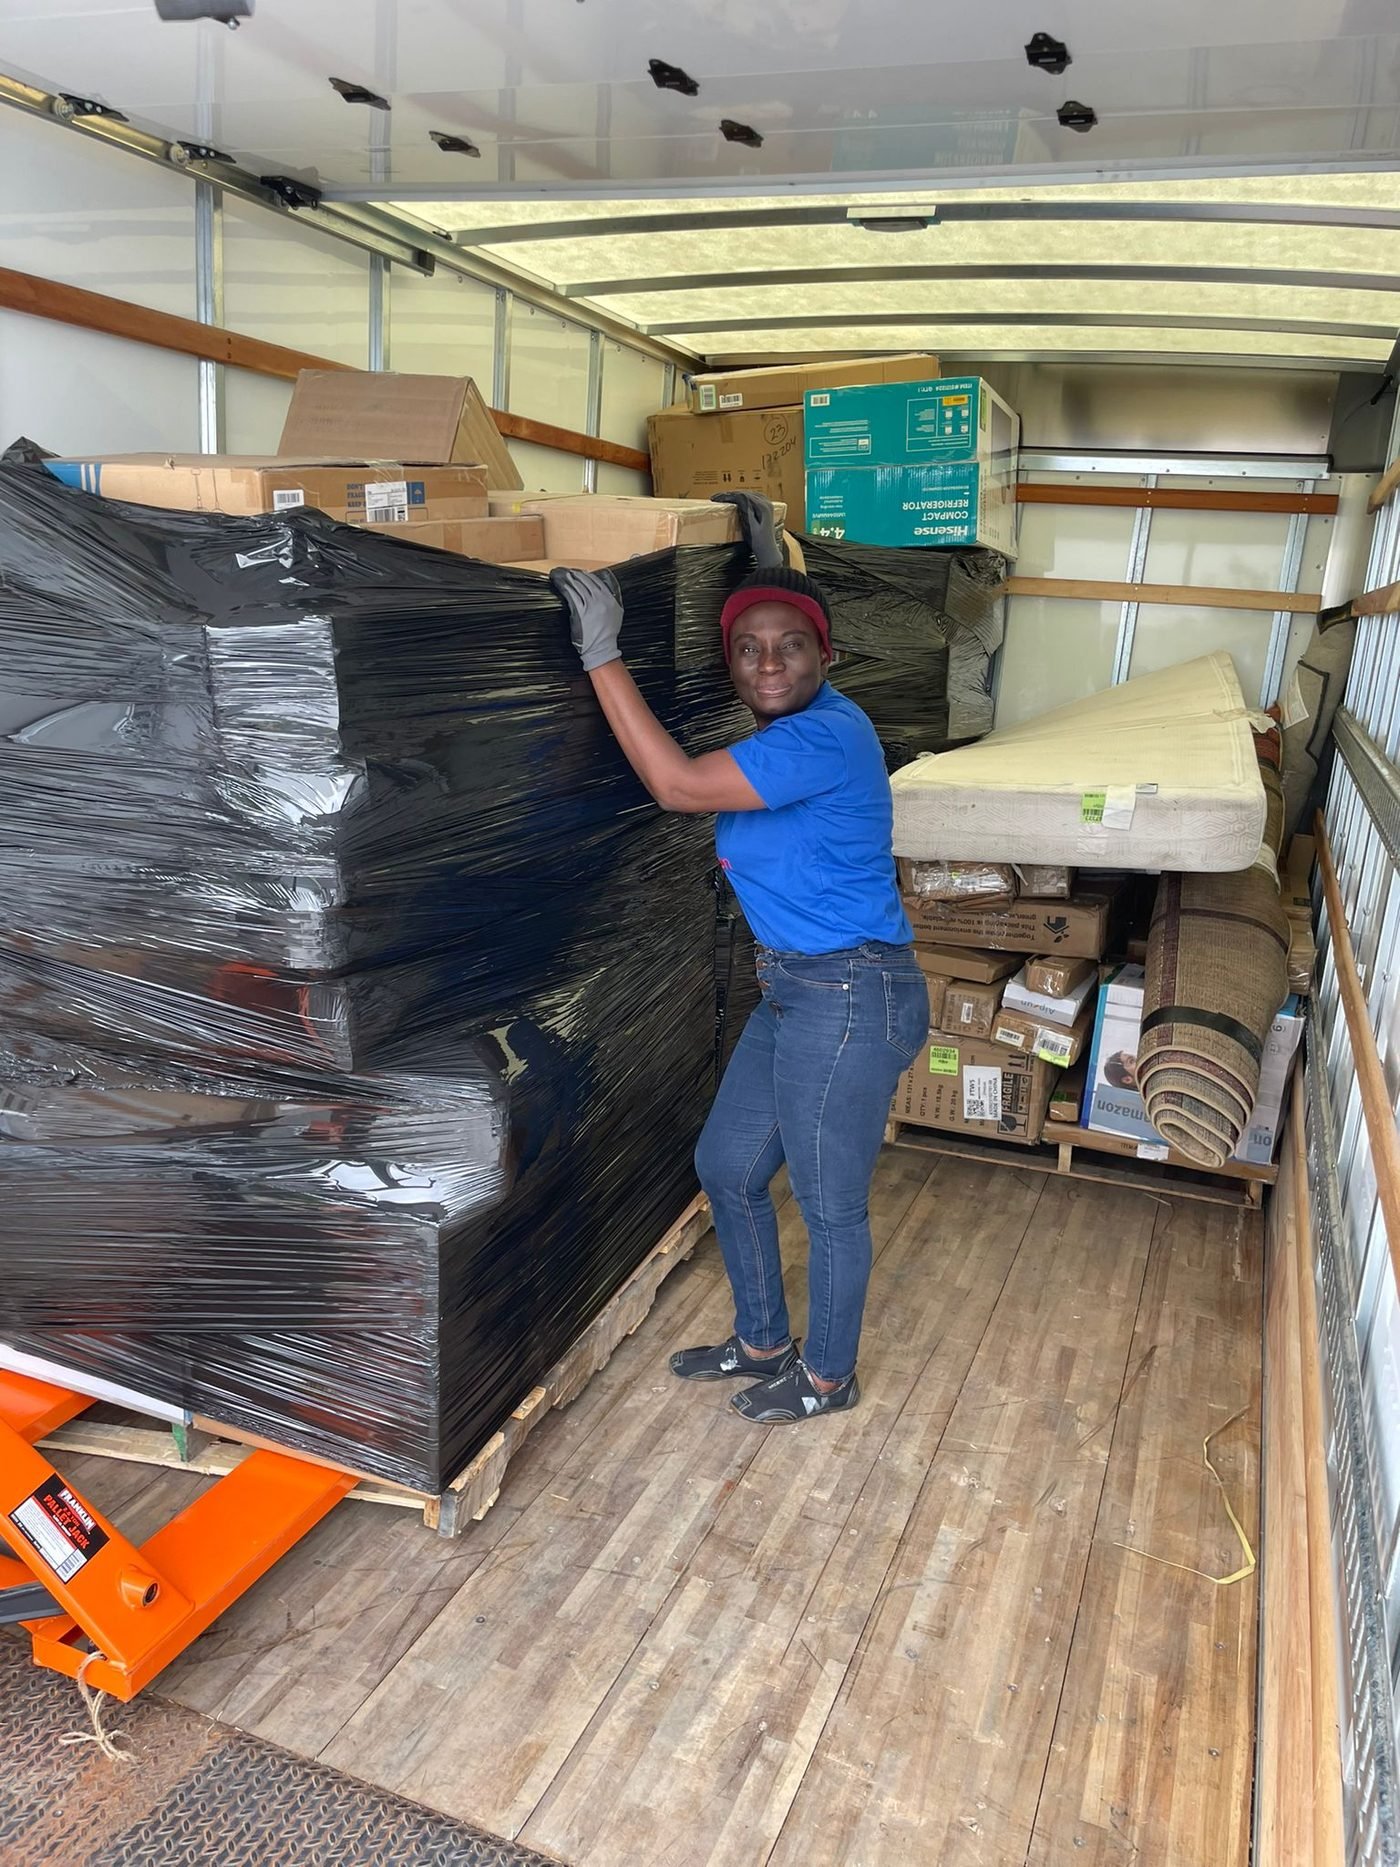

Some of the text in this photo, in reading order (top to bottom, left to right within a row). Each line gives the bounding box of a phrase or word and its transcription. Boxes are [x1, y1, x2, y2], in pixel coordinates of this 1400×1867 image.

[769, 422, 786, 442] 23
[902, 498, 969, 510] REFRIGERATOR
[921, 510, 969, 521] COMPACT
[913, 525, 969, 537] Hisense
[1005, 930, 1036, 940] Together
[1002, 1072, 1014, 1112] FRAGILE
[60, 1489, 96, 1529] FRANKLIN
[43, 1493, 72, 1525] PALLET
[68, 1524, 90, 1549] JACK
